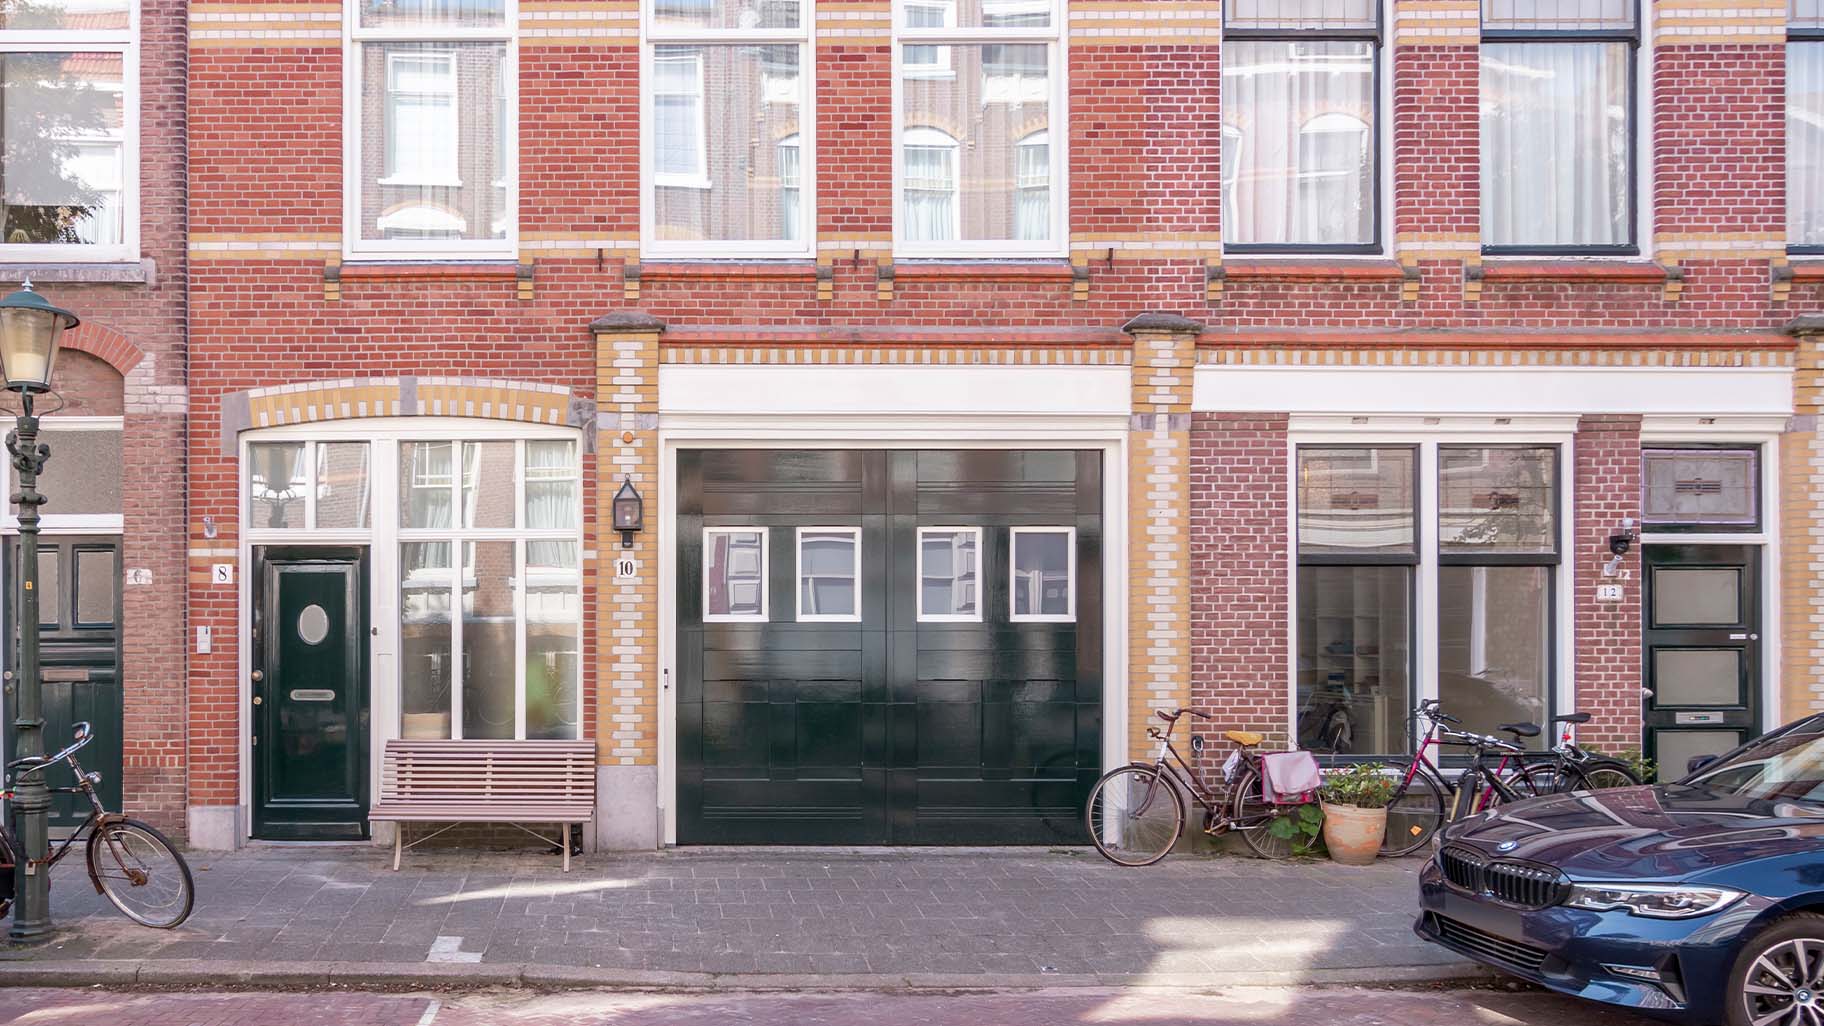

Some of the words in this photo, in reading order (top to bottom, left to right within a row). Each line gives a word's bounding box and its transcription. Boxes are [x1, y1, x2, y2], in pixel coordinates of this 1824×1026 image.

[218, 566, 227, 581] 8
[619, 560, 633, 575] 10
[1604, 587, 1616, 597] 12
